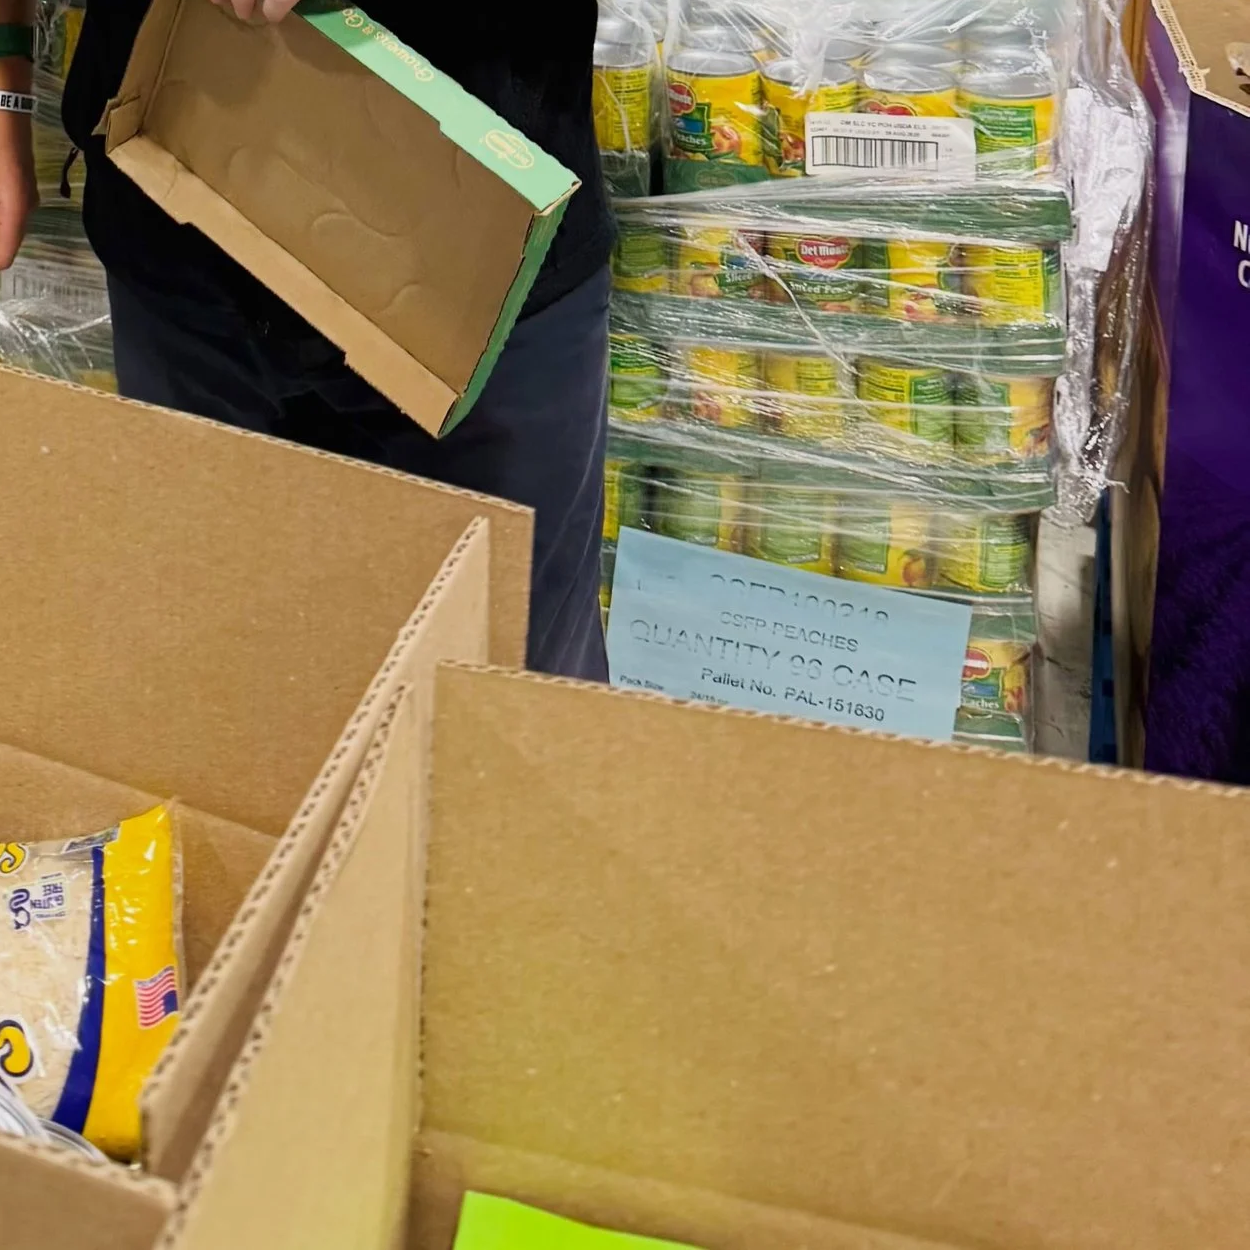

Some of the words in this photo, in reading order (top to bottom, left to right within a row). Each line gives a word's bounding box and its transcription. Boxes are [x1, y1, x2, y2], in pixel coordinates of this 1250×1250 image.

[374, 31, 435, 83] Growers
[0, 94, 13, 107] BE
[801, 245, 817, 255] Del
[629, 618, 781, 671] QUANTITY
[833, 663, 918, 703] CASE
[700, 667, 746, 689] Pallet
[749, 678, 777, 698] No.
[42, 882, 63, 897] FREE
[30, 895, 64, 910] GLUTEN
